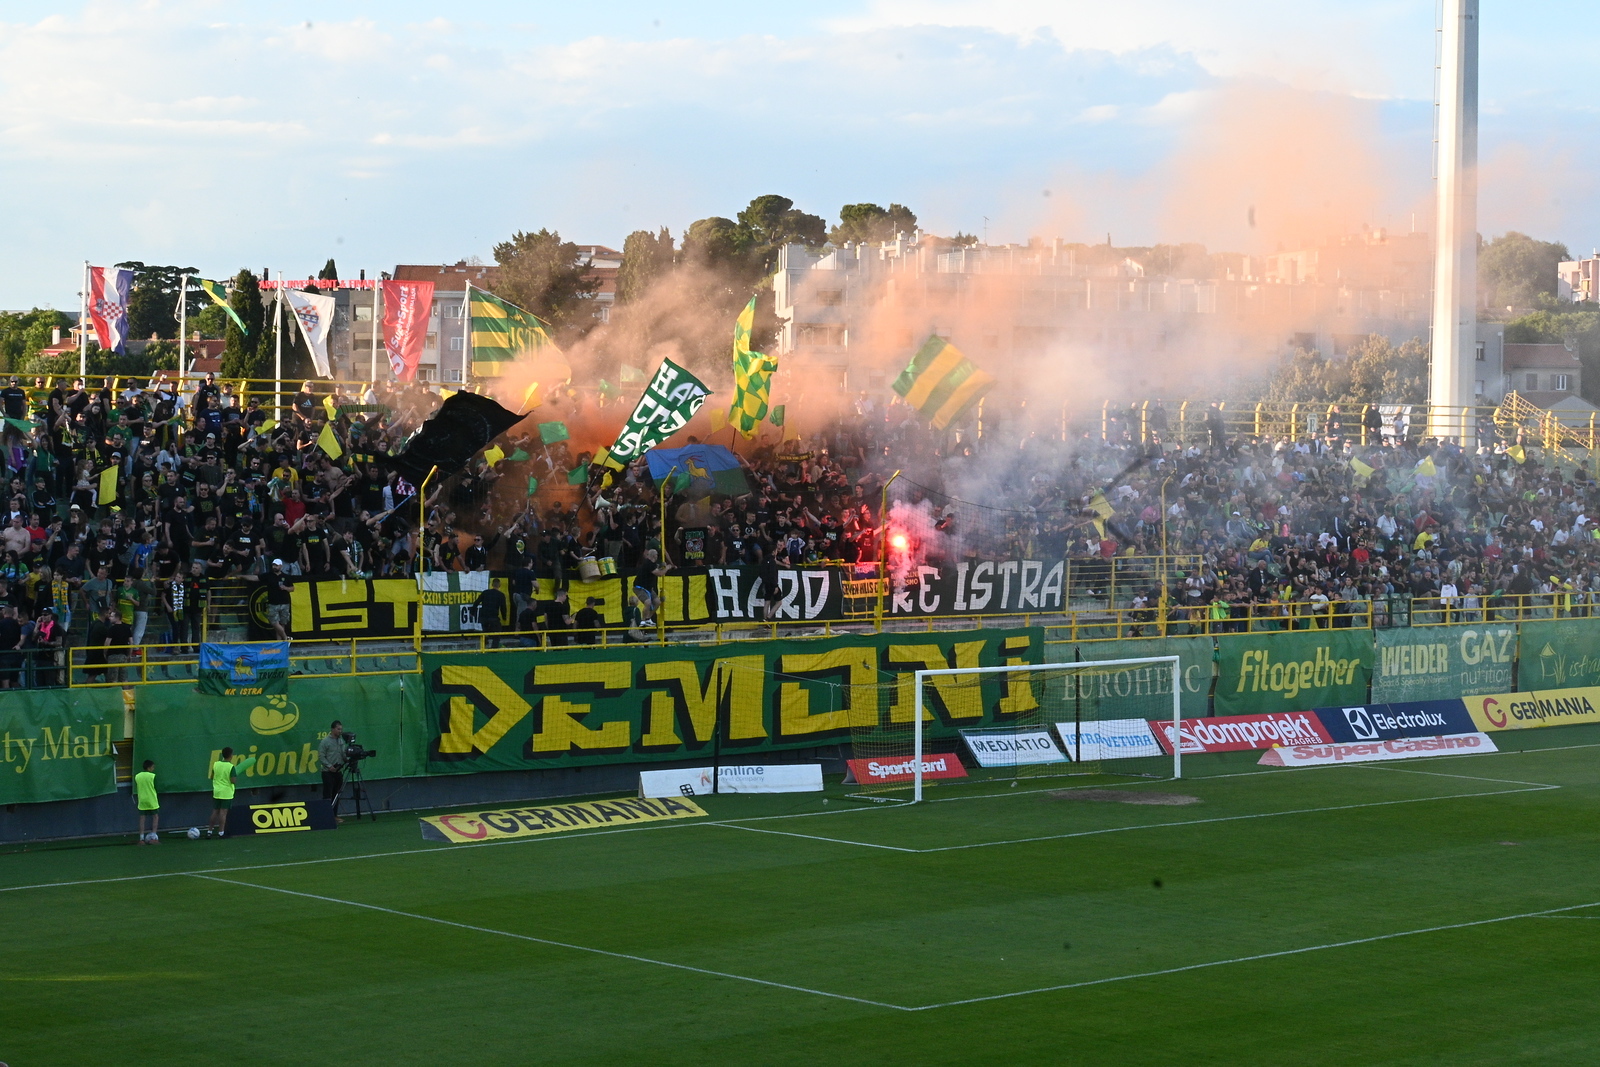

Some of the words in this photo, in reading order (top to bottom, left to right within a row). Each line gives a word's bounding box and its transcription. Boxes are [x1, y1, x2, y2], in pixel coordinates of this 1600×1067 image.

[391, 285, 409, 349] SuperSport
[953, 560, 1064, 611] ISTRA
[1381, 643, 1449, 677] WEIDER
[1461, 629, 1512, 665] GAZ
[1236, 646, 1360, 699] Fitogether
[225, 688, 237, 696] NK
[240, 687, 263, 695] ISTRA
[1372, 710, 1447, 730] Electrolux
[1510, 697, 1596, 721] GERMANIA
[41, 724, 112, 760] Mall
[973, 737, 1050, 752] MEDIATIO
[1193, 714, 1318, 748] domprojekt
[1288, 736, 1323, 746] ZAGREB
[252, 807, 308, 828] OMP
[479, 797, 696, 834] GERMANIA
